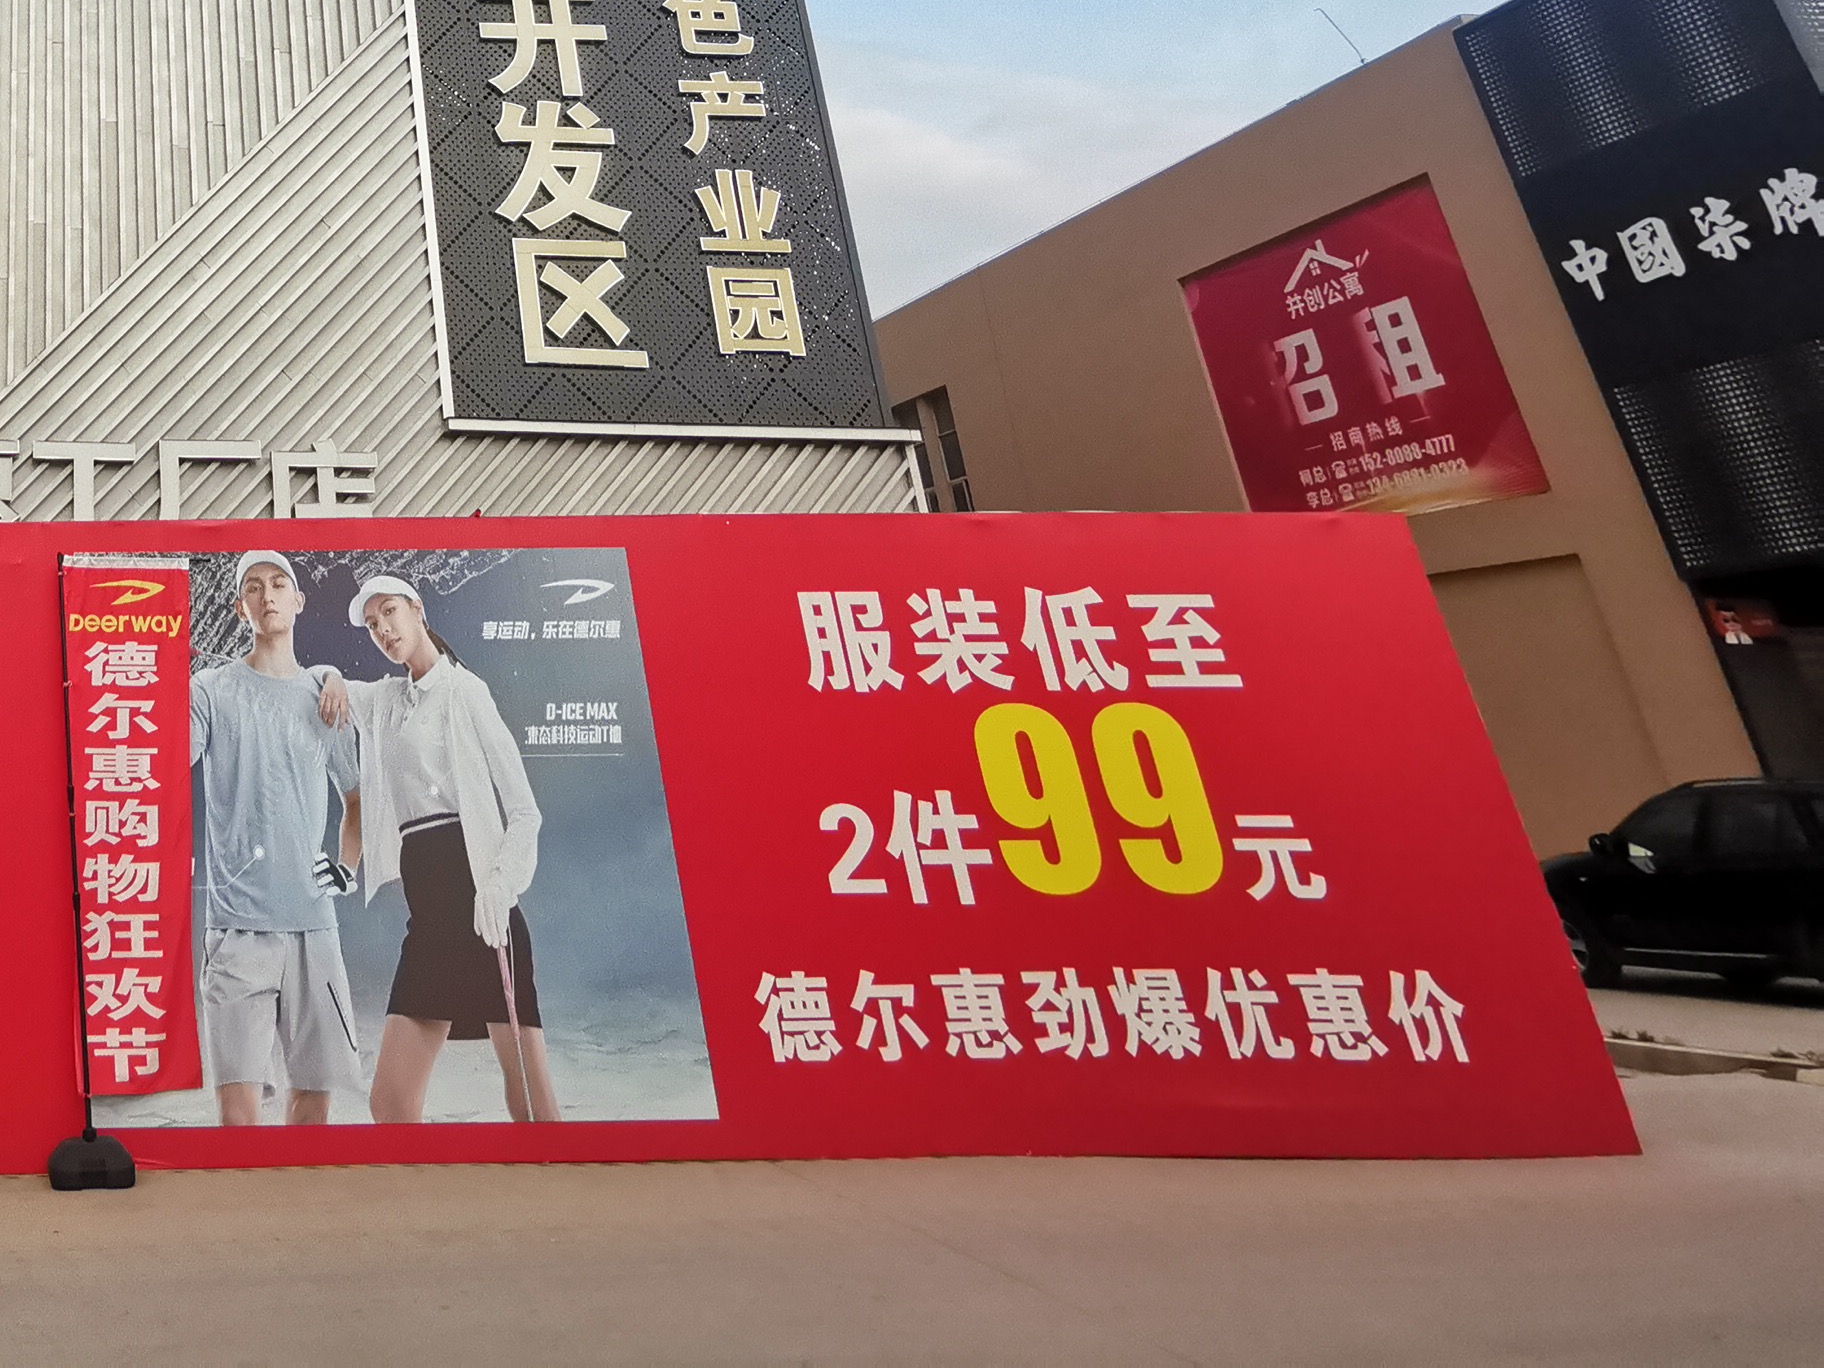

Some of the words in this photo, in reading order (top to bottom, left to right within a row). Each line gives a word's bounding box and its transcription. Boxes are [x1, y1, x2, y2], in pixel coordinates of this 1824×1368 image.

[1330, 416, 1403, 452] 招商热线
[69, 614, 182, 638] Deerway
[796, 586, 1243, 693] 服装低至
[546, 703, 584, 720] D-ICE
[586, 703, 618, 720] MAX
[83, 641, 166, 1082] 德尔惠购物狂欢节
[753, 966, 1470, 1063] 德尔惠劲爆优惠价
